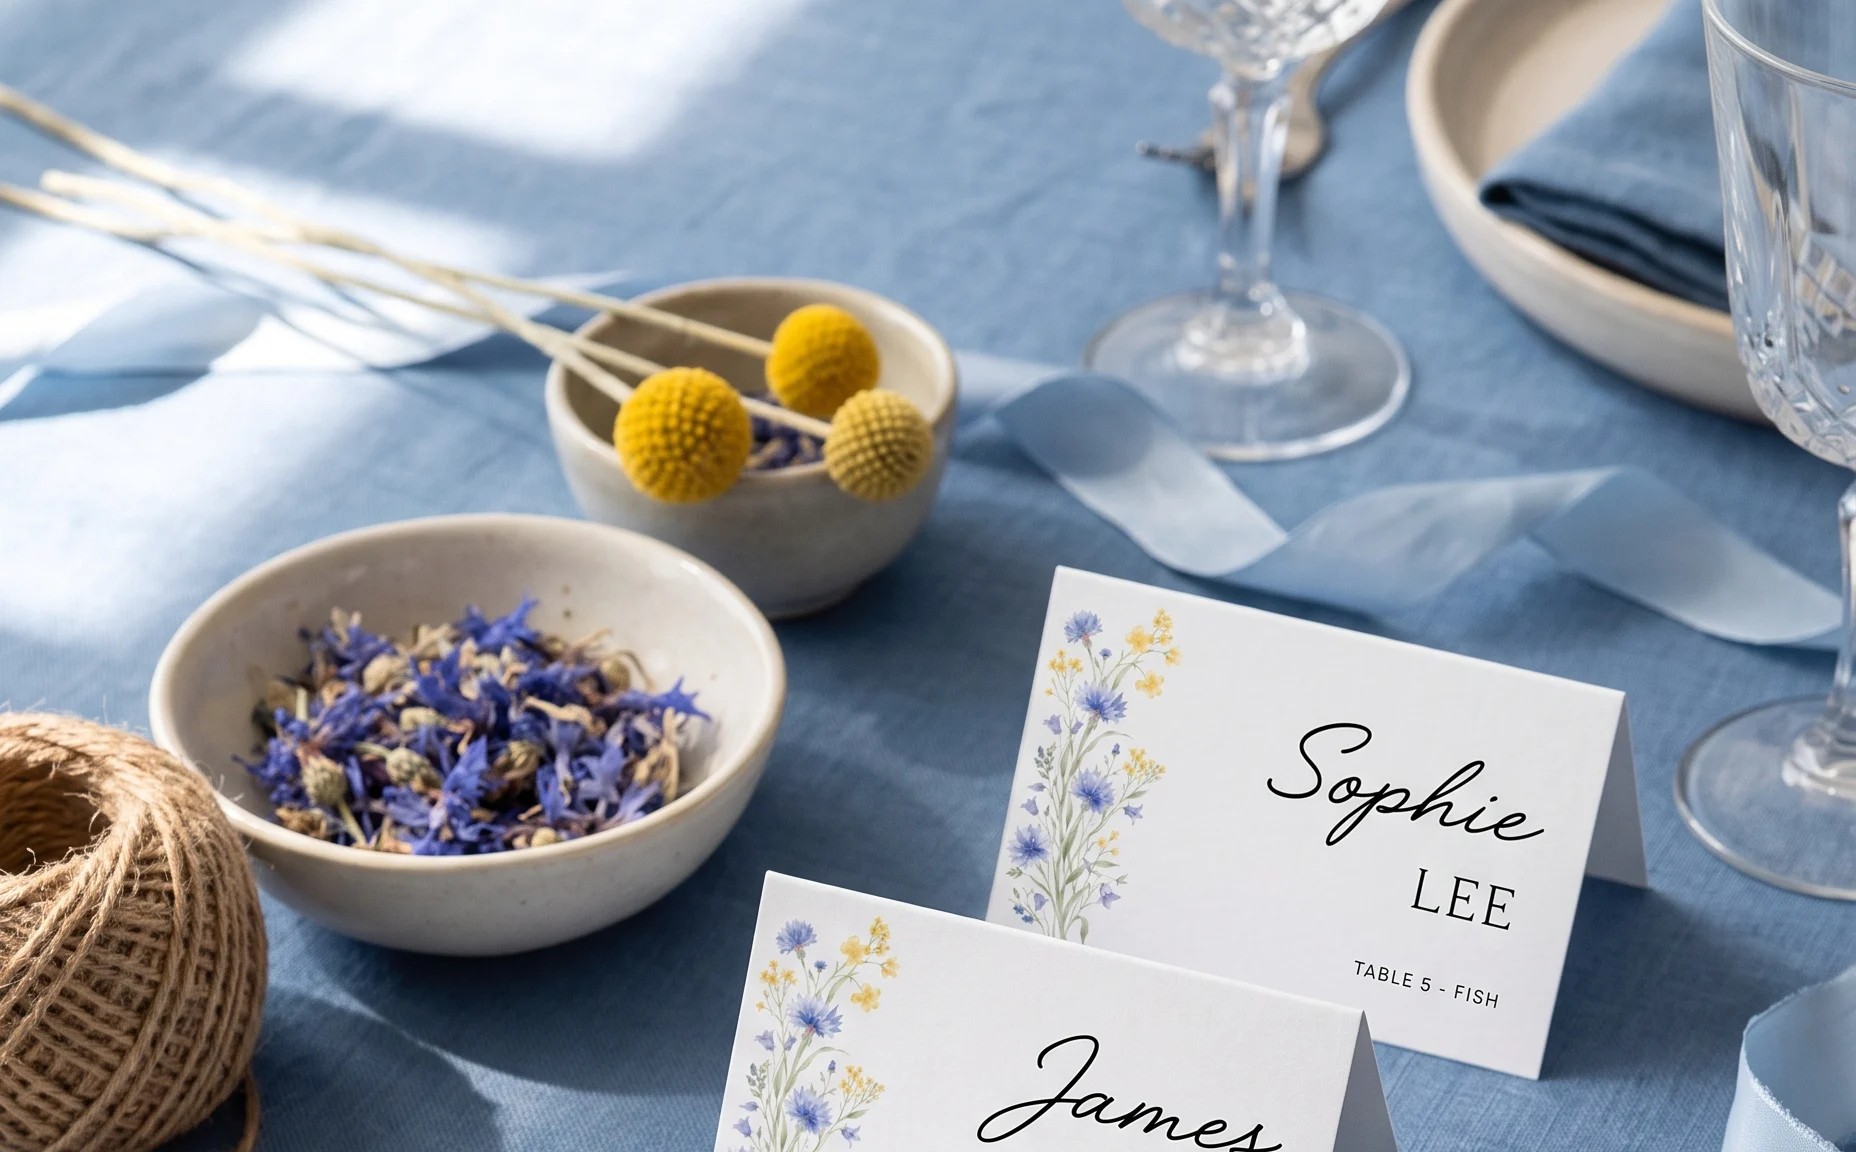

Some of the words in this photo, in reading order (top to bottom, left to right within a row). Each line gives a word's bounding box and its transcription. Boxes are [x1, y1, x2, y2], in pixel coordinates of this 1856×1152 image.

[1265, 722, 1546, 847] Sophie
[1410, 867, 1517, 931] LEE
[1354, 960, 1414, 988] TABLE
[1420, 977, 1432, 992] 5
[1454, 984, 1499, 1009] FISH
